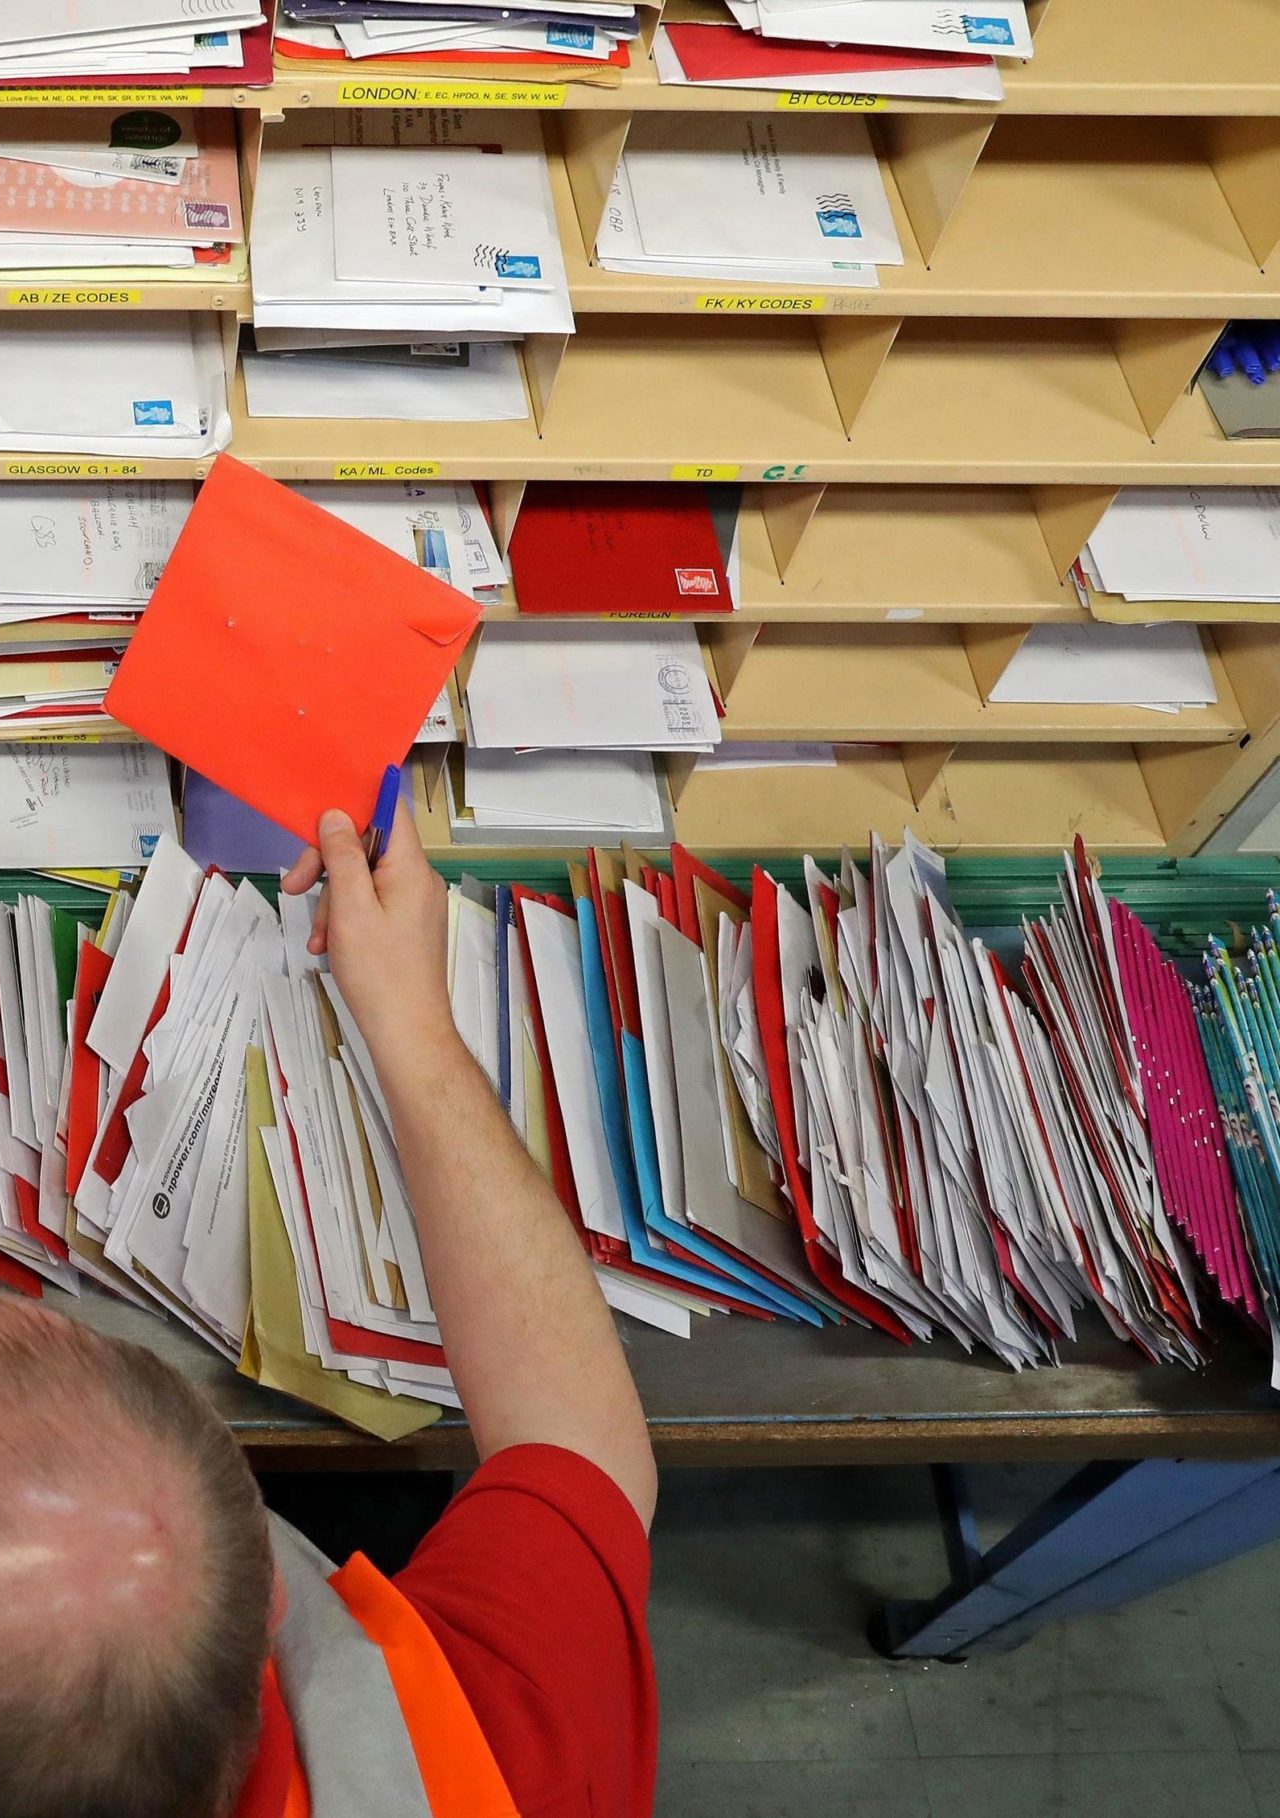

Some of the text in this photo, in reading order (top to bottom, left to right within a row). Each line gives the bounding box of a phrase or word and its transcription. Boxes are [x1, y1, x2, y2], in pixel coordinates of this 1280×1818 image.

[342, 86, 421, 101] LONDON:
[788, 92, 878, 107] BT CODES
[19, 292, 129, 303] AB / ZE CODES
[705, 298, 724, 309] FK
[736, 298, 758, 309] KY
[759, 299, 813, 310] CODES
[9, 465, 81, 475] GLASGOW
[121, 465, 138, 474] 84
[340, 467, 358, 476] KA
[394, 466, 434, 475] Codes
[695, 468, 714, 478] TD
[159, 1158, 175, 1187] Activate
[171, 1141, 182, 1159] your
[178, 1115, 194, 1143] account
[190, 1094, 203, 1116] online
[199, 1075, 212, 1095] today
